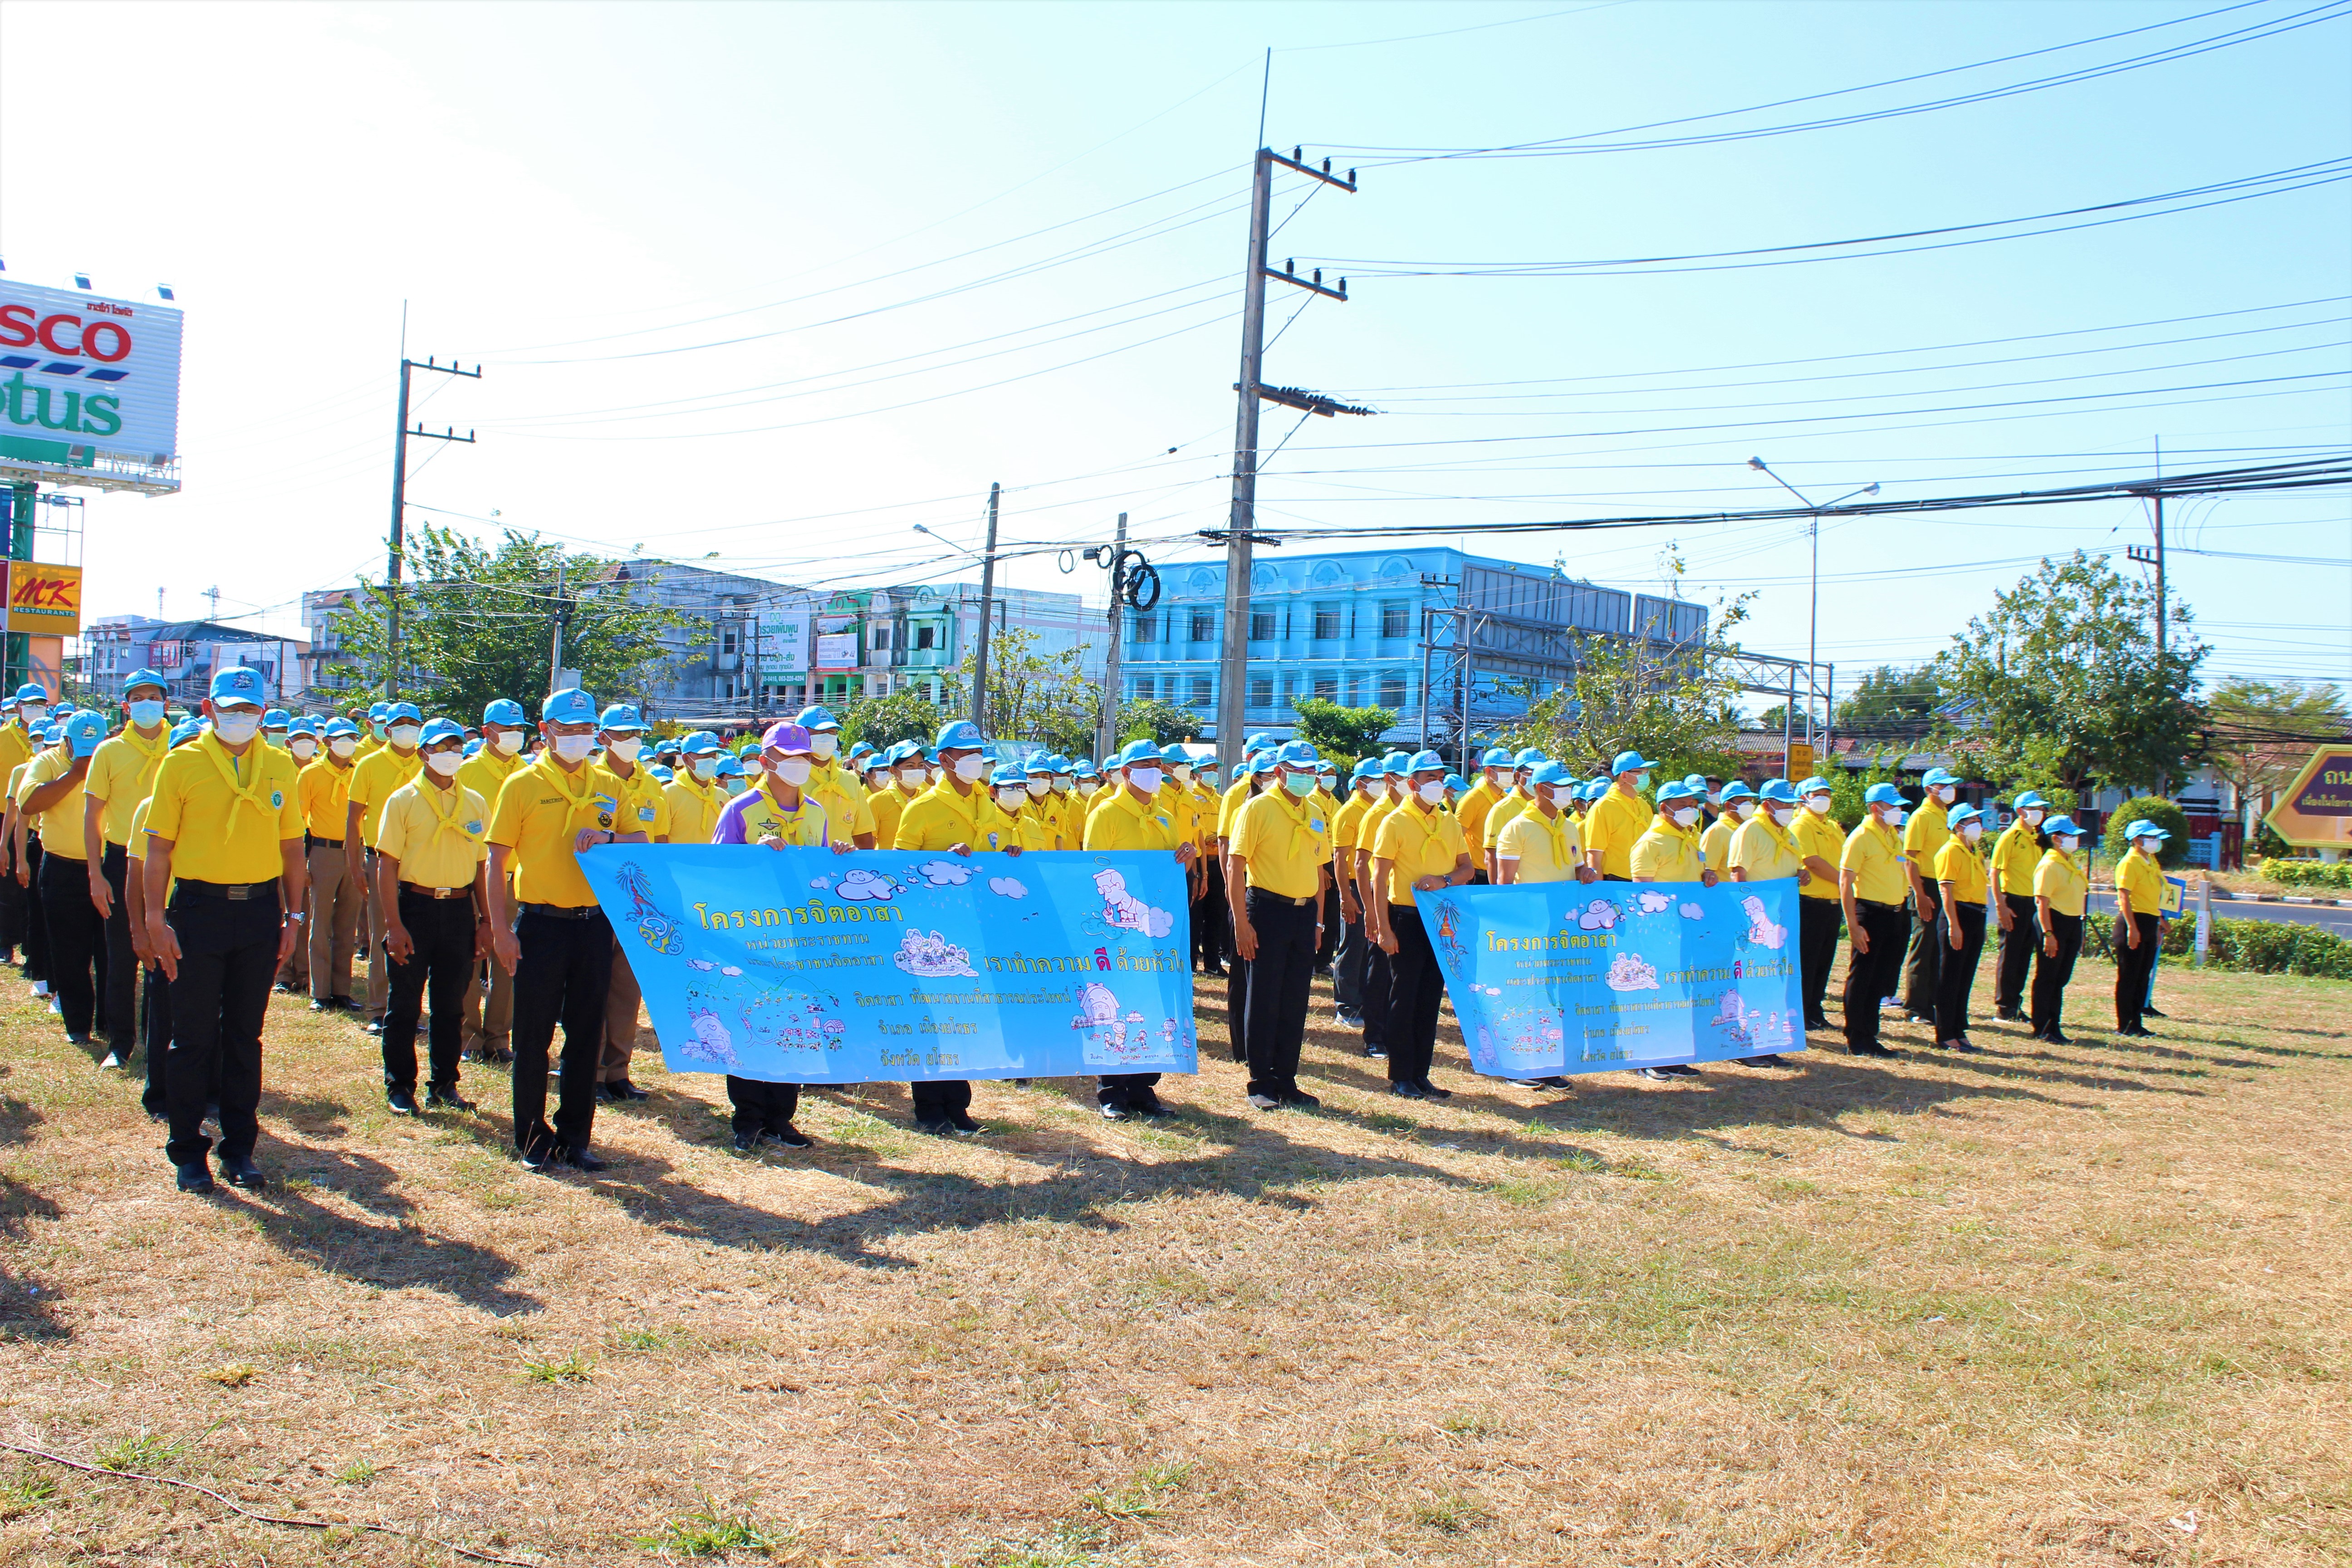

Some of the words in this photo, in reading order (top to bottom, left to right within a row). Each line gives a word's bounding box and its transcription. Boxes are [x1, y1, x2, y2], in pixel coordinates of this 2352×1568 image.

[0, 372, 122, 436] tus
[14, 577, 76, 608] MK
[14, 607, 75, 617] RESTAURANTS
[692, 898, 904, 930] โครงการจิตอาสา
[745, 933, 869, 951] หน่วยพระราชทาน
[1485, 929, 1617, 952] โครงการจิตอาสา
[984, 952, 1092, 973] เราทำความ
[1094, 946, 1112, 971] ดี
[1116, 946, 1184, 974] ด้วยหัวใจ
[1515, 955, 1592, 969] หน่วยพระราชทาน
[1665, 965, 1730, 984] เราทำความ
[1734, 960, 1743, 979] ดี
[1746, 956, 1793, 979] ด้วยหัวใจ
[853, 991, 904, 1007] จิตอาสา
[1575, 1003, 1605, 1015] จิตอาสา
[878, 1019, 912, 1036] อำเภอ
[919, 1015, 978, 1035] เมืองยโสธร
[880, 1049, 920, 1067] จังหวัด
[926, 1047, 960, 1067] ยโสธร
